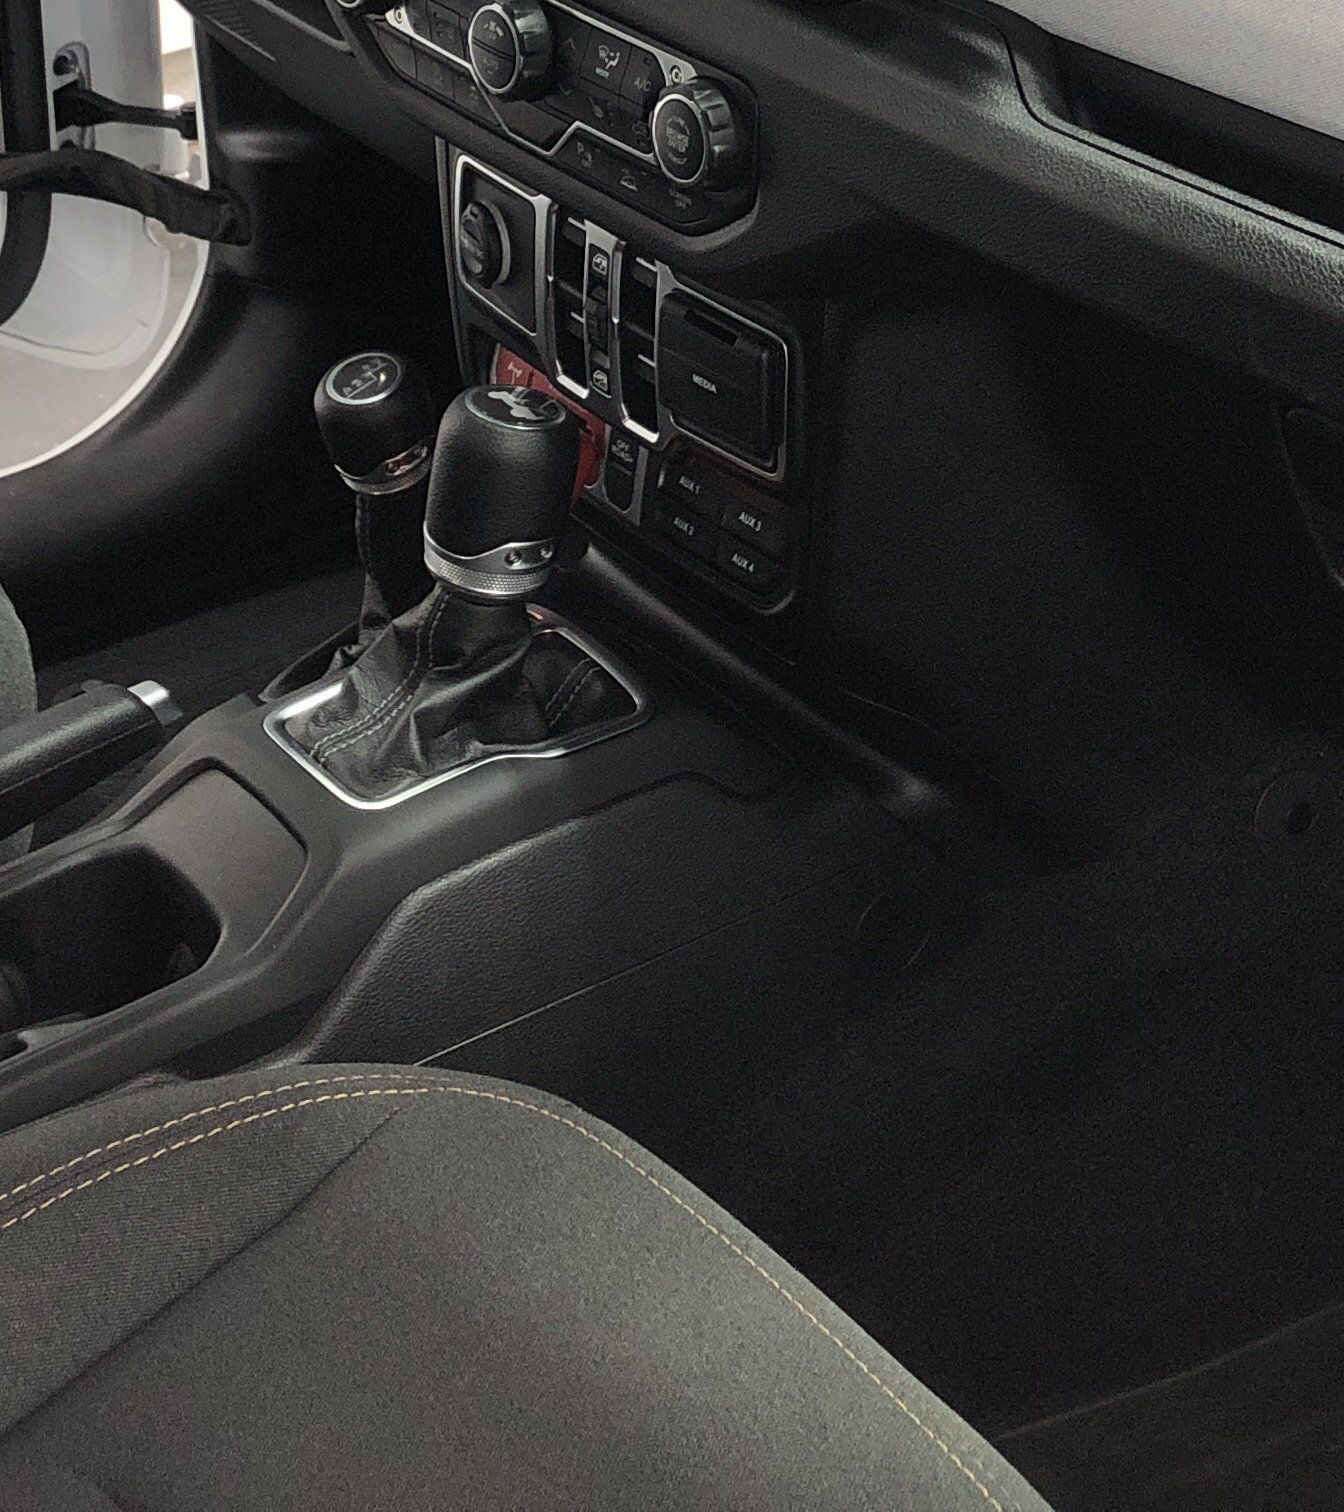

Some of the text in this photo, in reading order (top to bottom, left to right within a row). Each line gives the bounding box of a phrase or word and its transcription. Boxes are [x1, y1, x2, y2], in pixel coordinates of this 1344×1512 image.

[634, 76, 652, 92] A/C
[692, 373, 718, 394] MEDIA
[679, 475, 695, 491] AUX
[673, 517, 695, 536] AUX 2
[738, 511, 762, 532] AUX 3
[731, 553, 755, 574] AUX 4
